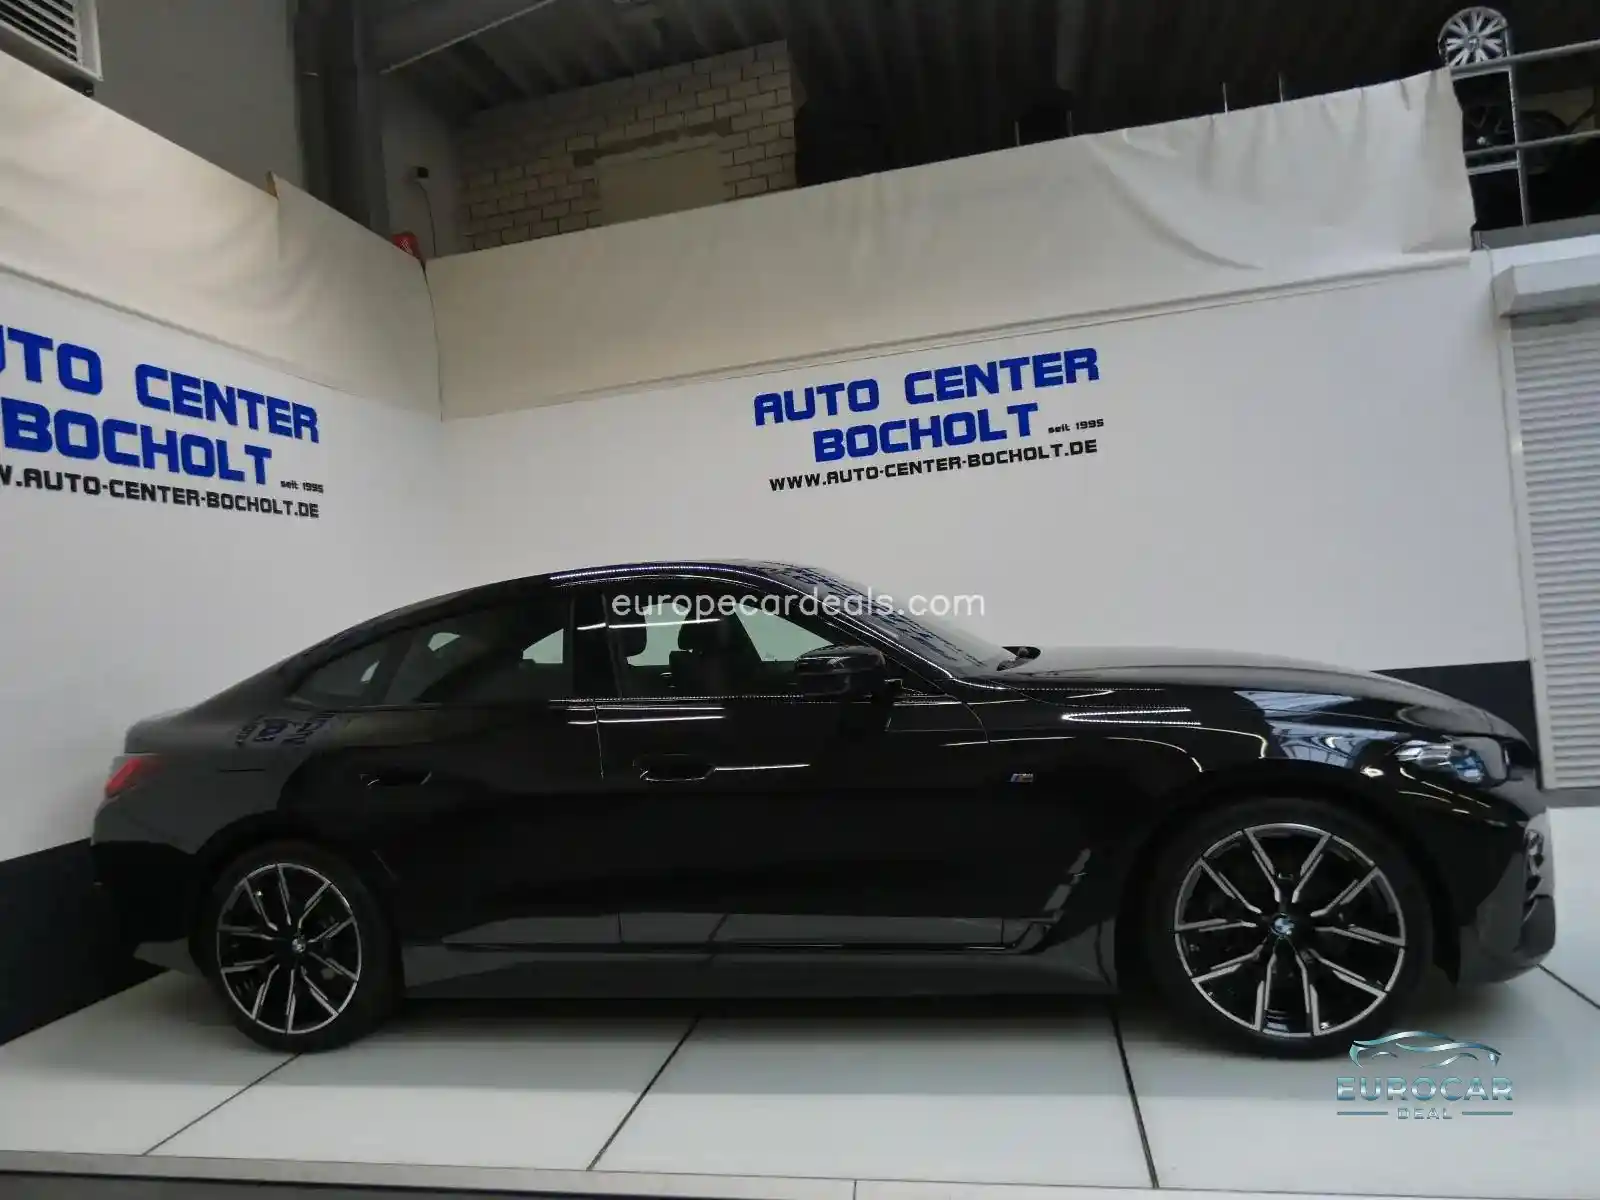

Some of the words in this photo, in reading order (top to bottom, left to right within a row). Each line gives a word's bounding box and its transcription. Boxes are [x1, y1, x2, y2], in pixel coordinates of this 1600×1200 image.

[0, 324, 103, 396] TO
[135, 364, 320, 444] CENTER
[754, 378, 880, 426] AUTO
[904, 347, 1099, 404] CENTER
[2, 397, 272, 485] BOCHOLT
[280, 480, 299, 489] seit
[302, 482, 324, 493] 1995
[769, 439, 1098, 491] WWW.AUTO-CENTER-BOCHOLT.DE
[813, 403, 1038, 463] BOCHOLT
[1048, 423, 1071, 434] seit
[1075, 418, 1104, 430] 1995
